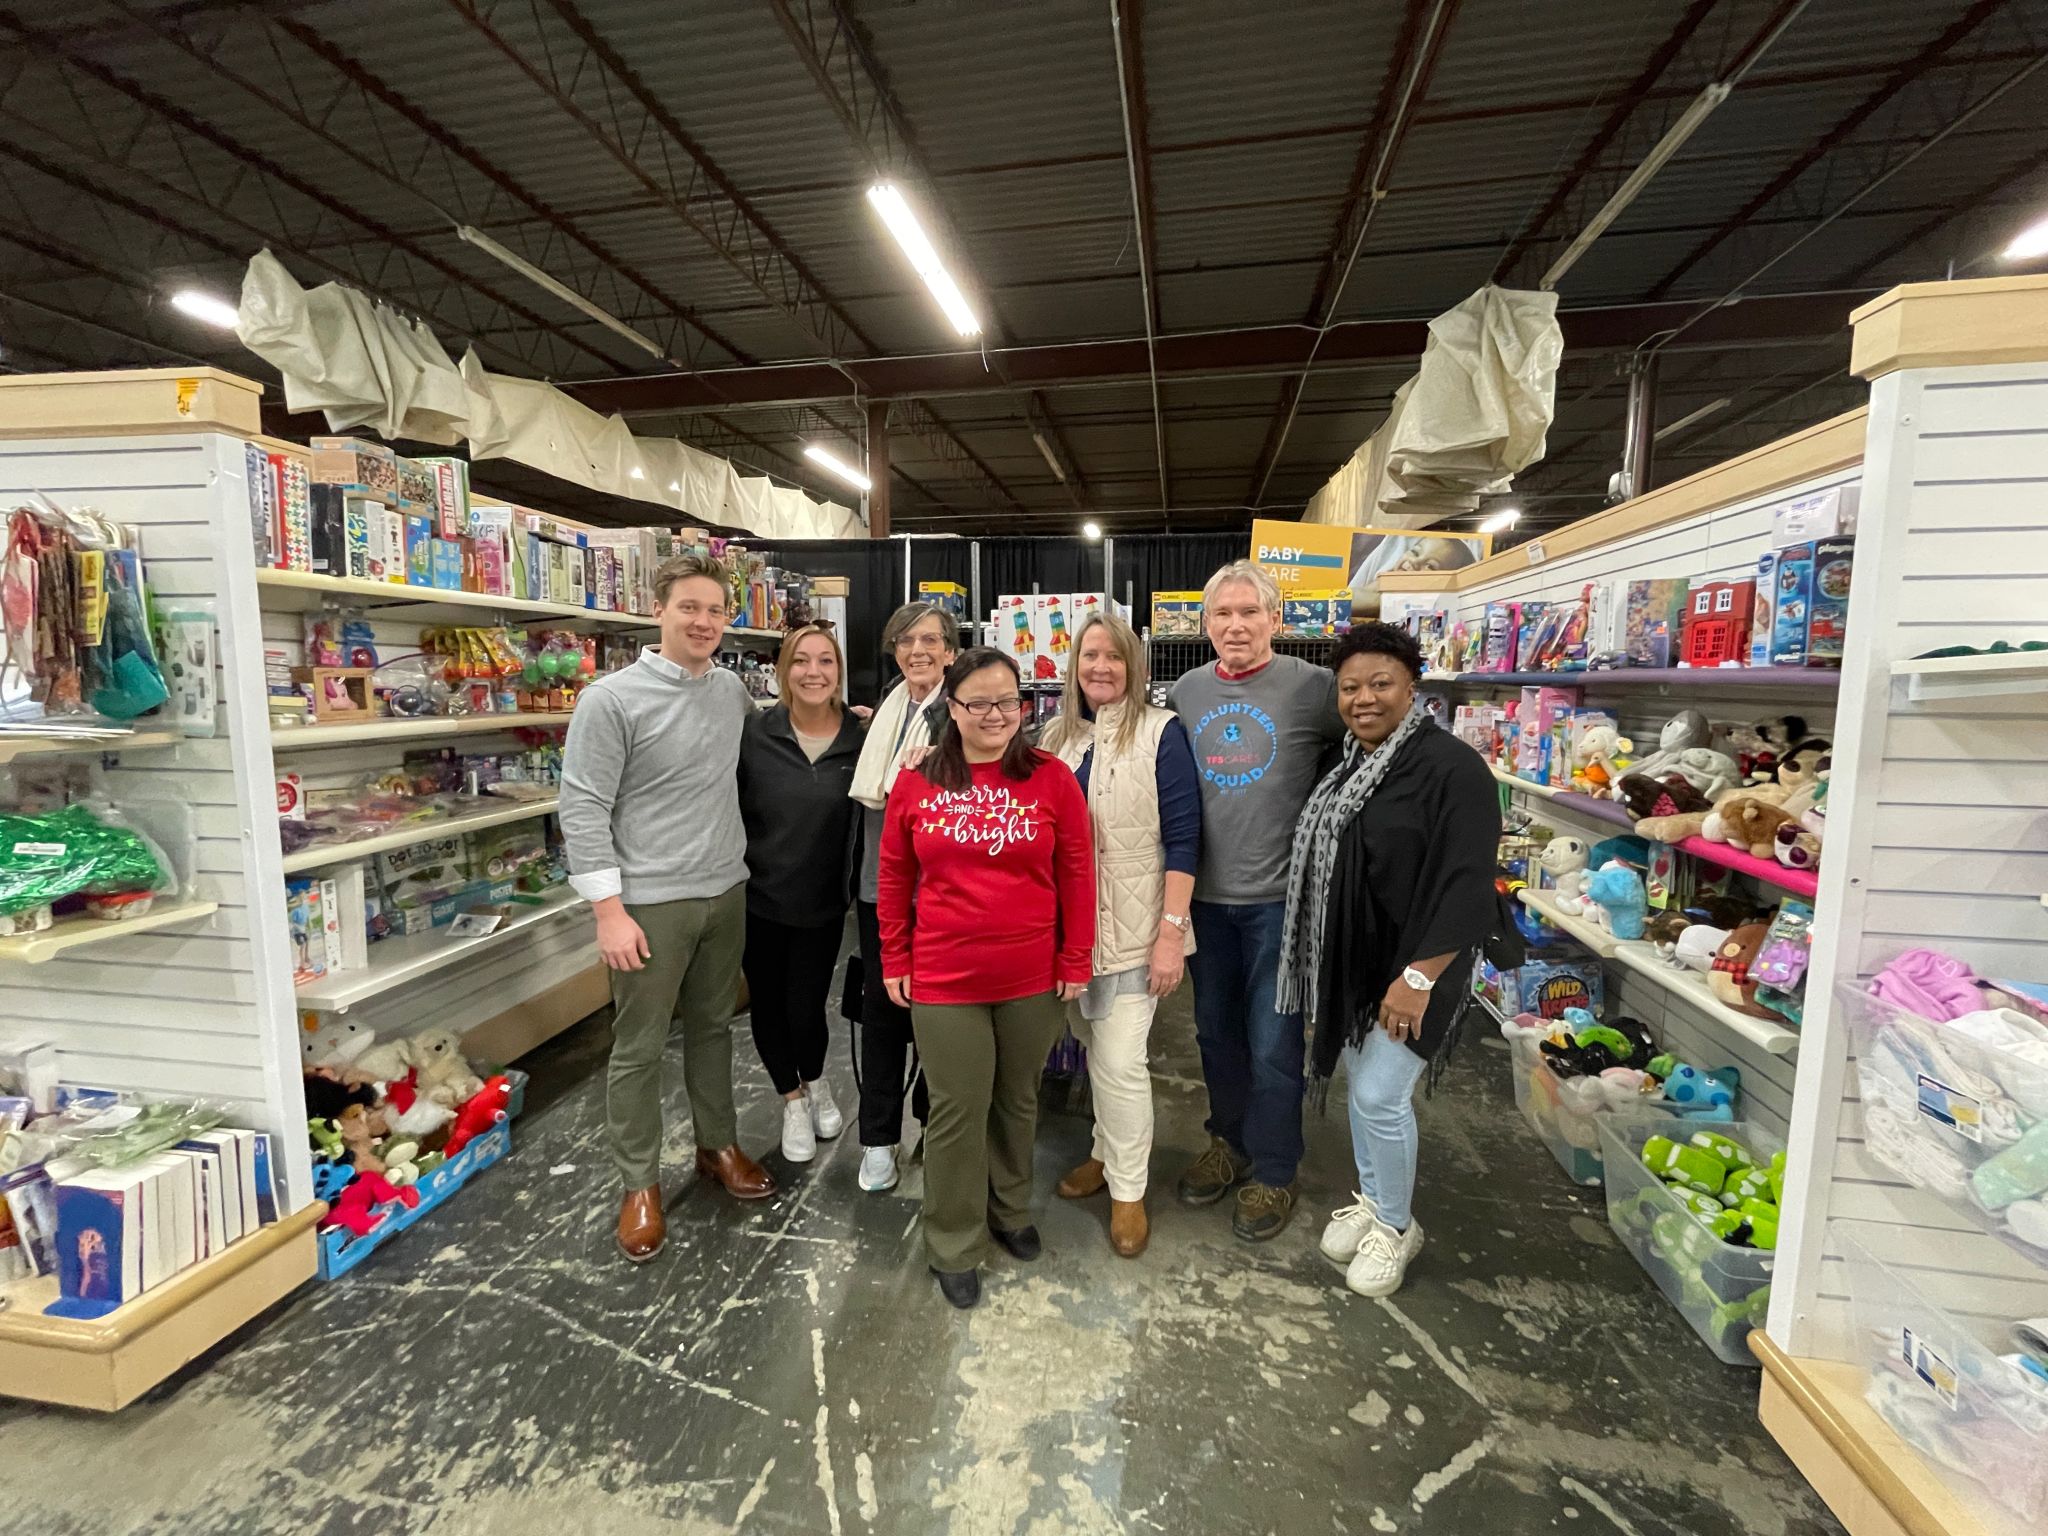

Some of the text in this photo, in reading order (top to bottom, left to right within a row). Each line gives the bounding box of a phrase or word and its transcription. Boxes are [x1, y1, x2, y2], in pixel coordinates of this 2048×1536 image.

[1258, 545, 1304, 562] BABY
[1194, 703, 1276, 735] VOLUNTEER
[1204, 767, 1264, 789] SQUAD
[932, 785, 1012, 818] merry
[953, 804, 975, 815] AND
[954, 814, 1039, 856] bright
[1548, 980, 1582, 1001] WILD
